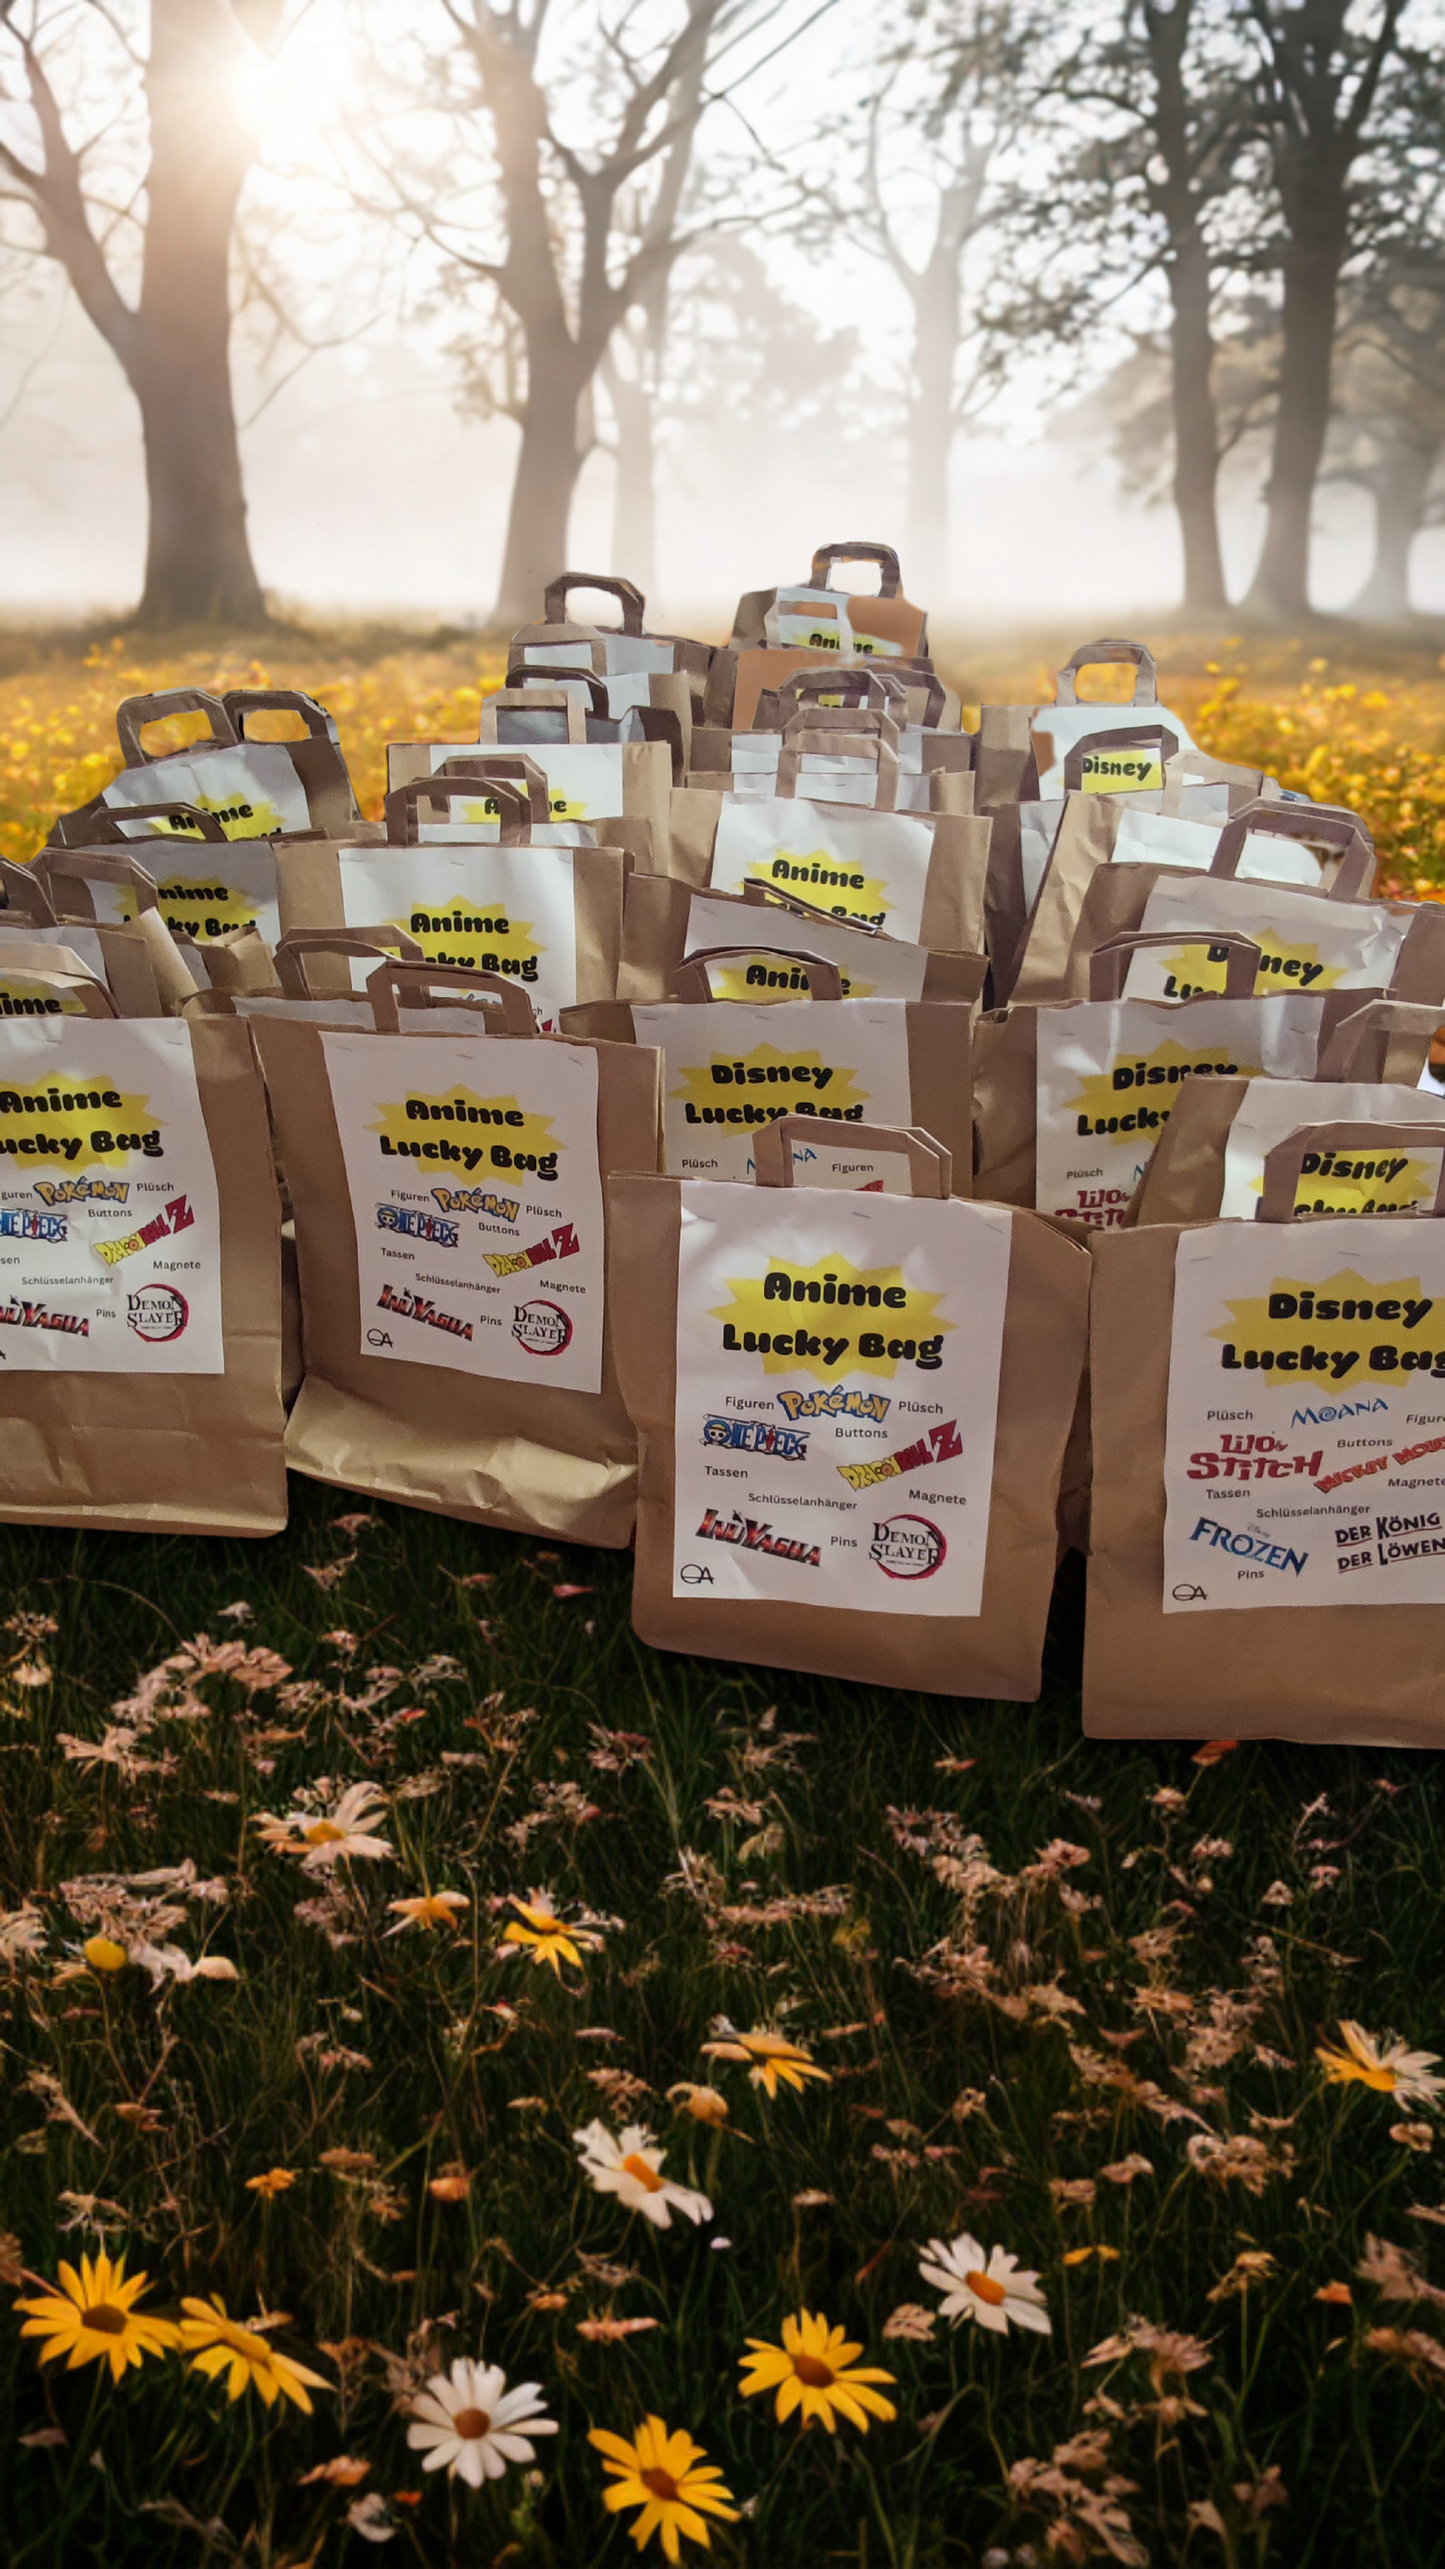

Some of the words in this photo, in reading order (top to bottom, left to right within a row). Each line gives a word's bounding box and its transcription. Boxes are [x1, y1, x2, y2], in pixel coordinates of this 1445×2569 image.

[1081, 755, 1153, 782] Disney
[168, 804, 254, 830] Ame
[771, 859, 865, 889] Anime
[157, 885, 229, 902] nime
[410, 910, 510, 934] Anime
[481, 952, 539, 982] Bag
[1207, 945, 1324, 987] Dney
[0, 992, 63, 1015] ime
[711, 1061, 833, 1090] Disney
[0, 1087, 123, 1114] Anime
[405, 1098, 525, 1127] Anime
[1077, 1107, 1170, 1136] Luck
[0, 1133, 83, 1161] ucky
[90, 1130, 164, 1158] Bag
[380, 1135, 483, 1171] Lucky
[490, 1145, 559, 1181] Bag
[681, 1158, 718, 1169] Plüsch
[1300, 1151, 1409, 1183] Disney
[832, 1163, 874, 1175] Figuren
[1066, 1167, 1104, 1179] Plüsch
[1, 1190, 33, 1201] guren
[136, 1181, 175, 1192] Plüsch
[391, 1188, 430, 1203] Figuren
[88, 1208, 133, 1218] Buttons
[525, 1204, 562, 1219] Plüsch
[478, 1221, 521, 1236] Buttons
[381, 1247, 416, 1261] Tassen
[153, 1259, 202, 1271] Magnete
[21, 1274, 115, 1286] Schlüsselanhänger
[415, 1272, 501, 1295] Schlüsselanhänger
[539, 1279, 587, 1295] Magnete
[763, 1271, 907, 1309] Anime
[126, 1293, 187, 1311] DEMON
[1268, 1290, 1433, 1329] Disney
[96, 1308, 117, 1319] Pins
[126, 1310, 186, 1328] SLAYER
[480, 1314, 503, 1326] Pins
[513, 1304, 569, 1331] DEMON
[511, 1322, 569, 1344] SLAYER
[722, 1323, 849, 1366] Lucky
[858, 1332, 944, 1370] Bag
[1221, 1343, 1360, 1380] Lucky
[725, 1395, 775, 1411] Figuren
[898, 1400, 944, 1415] Plüsch
[1207, 1409, 1253, 1421] Plüsch
[1290, 1397, 1389, 1429] MOANA
[1406, 1413, 1445, 1426] Figur
[835, 1427, 888, 1439] Buttons
[928, 1419, 964, 1463] Z
[1336, 1436, 1393, 1448] Buttons
[704, 1465, 749, 1479] Tassen
[1313, 1455, 1389, 1494] MICKEY
[748, 1491, 858, 1511] Schlüsselanhänger
[908, 1489, 967, 1506] Magnete
[1205, 1488, 1251, 1500] Tassen
[1256, 1504, 1372, 1519] Schlüsselanhänger
[873, 1522, 944, 1549] DEMON
[1335, 1524, 1373, 1544] DER
[1375, 1512, 1441, 1541] KÖNIG
[830, 1535, 858, 1548] Pins
[1188, 1516, 1310, 1578] FROZEN
[868, 1543, 943, 1567] SLAYER
[1337, 1550, 1373, 1571] DER
[1238, 1569, 1265, 1580] Pins
